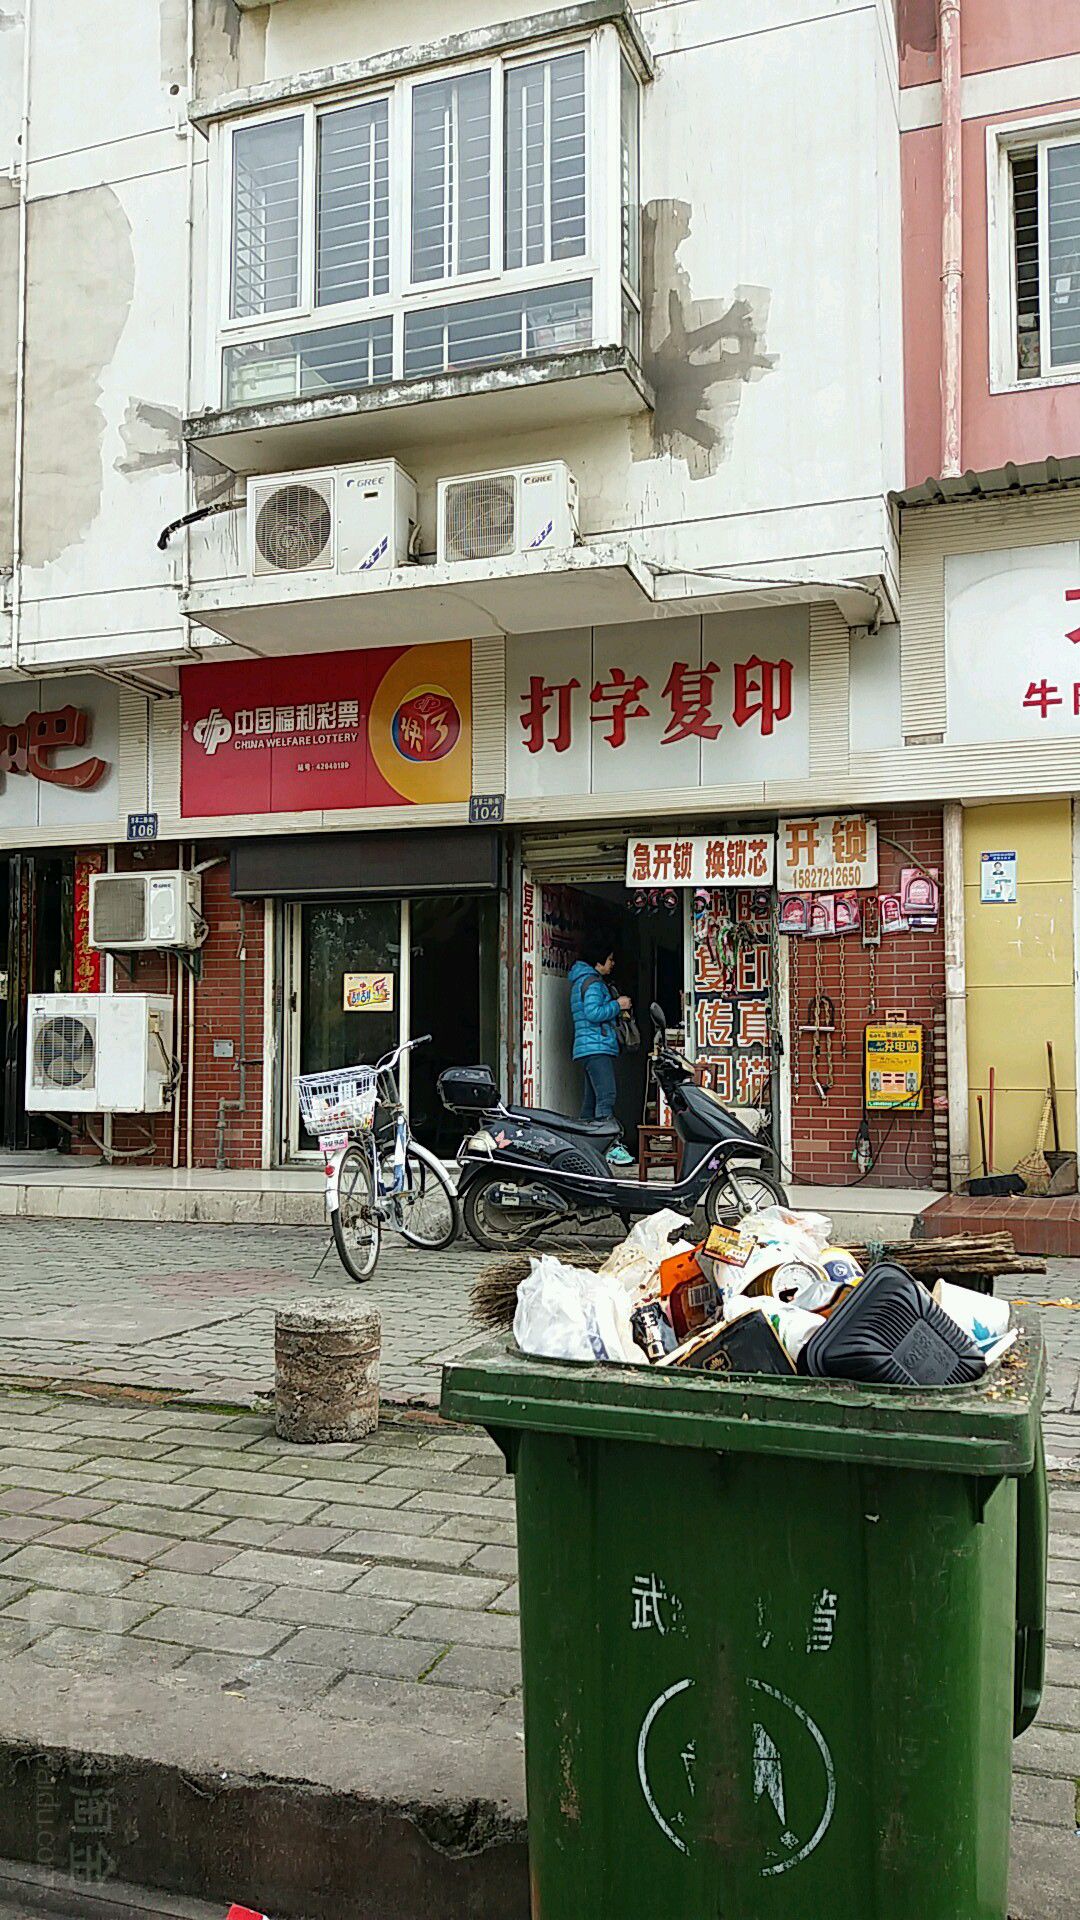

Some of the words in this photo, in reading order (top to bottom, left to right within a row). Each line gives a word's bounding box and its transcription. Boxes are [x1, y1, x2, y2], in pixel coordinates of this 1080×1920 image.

[357, 476, 385, 488] GREE
[234, 700, 359, 736] 中国福利彩票
[519, 654, 794, 753] 打字复印
[234, 738, 265, 750] CHINA
[266, 735, 312, 748] WELFARE
[312, 732, 358, 744] LOTTERY
[474, 806, 500, 820] 104
[131, 825, 154, 837] 106
[785, 820, 867, 867] 开锁
[632, 841, 694, 881] 急开锁
[705, 839, 768, 879] 换锁芯
[792, 866, 862, 889] 15827212650
[697, 1000, 770, 1046] 传真
